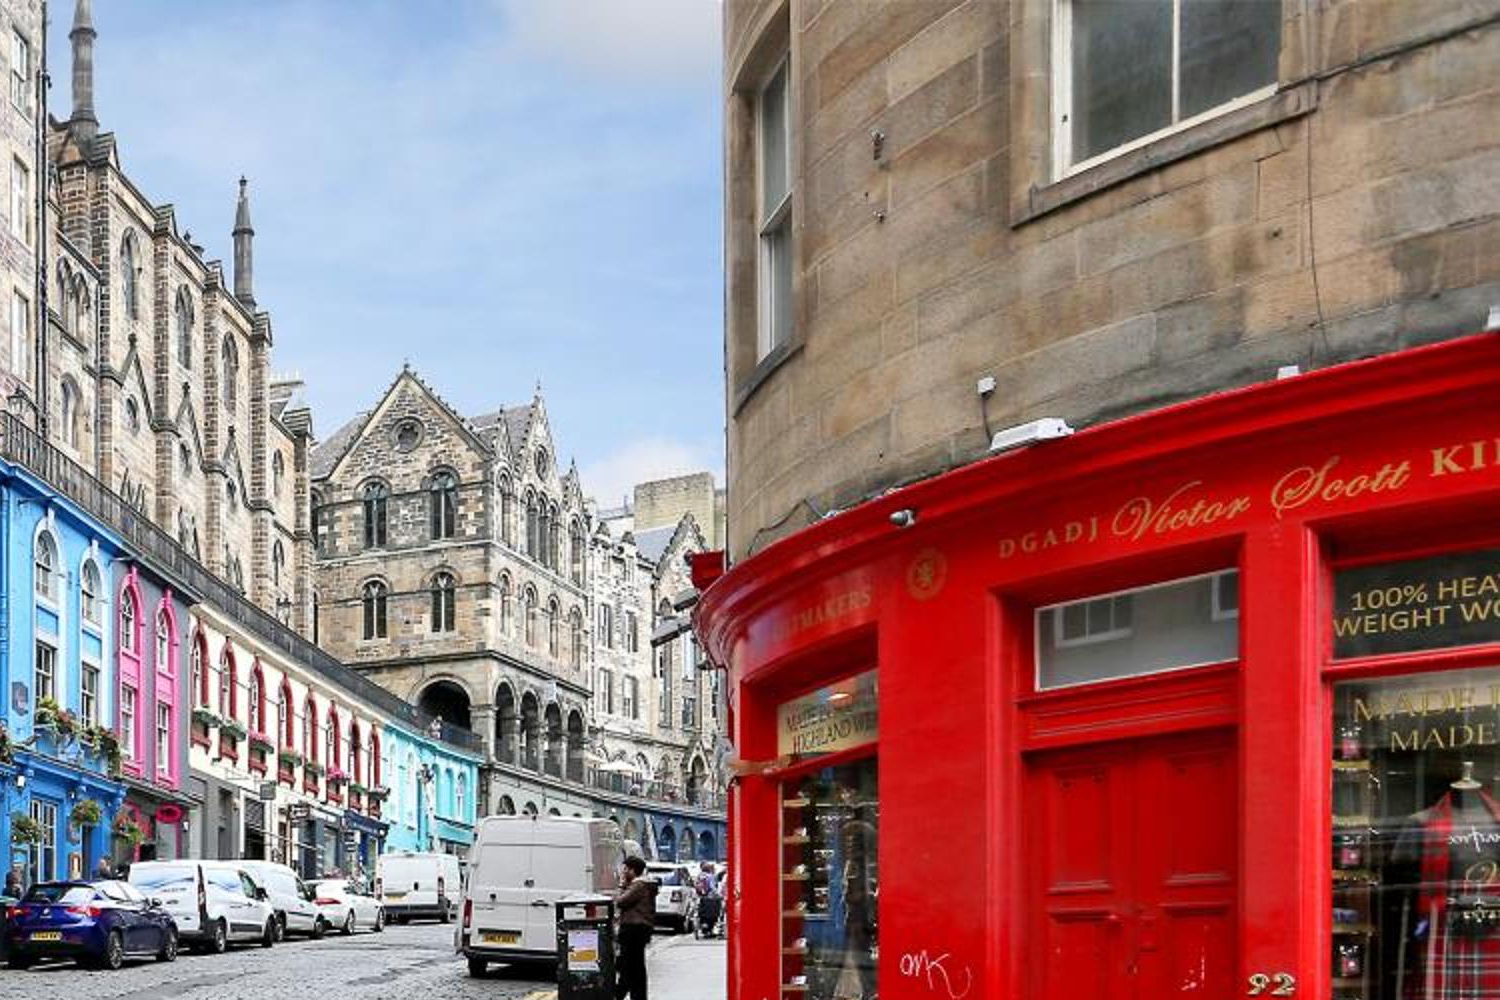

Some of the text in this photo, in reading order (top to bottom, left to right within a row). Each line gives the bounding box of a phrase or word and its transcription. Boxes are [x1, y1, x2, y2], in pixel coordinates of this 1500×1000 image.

[1112, 480, 1250, 542] Victor
[1271, 455, 1410, 520] Scott
[1431, 438, 1500, 477] KI
[1351, 583, 1428, 611] 100%
[1333, 605, 1452, 638] WEIGHT
[1391, 723, 1493, 753] MADE
[1246, 972, 1296, 997] 92
